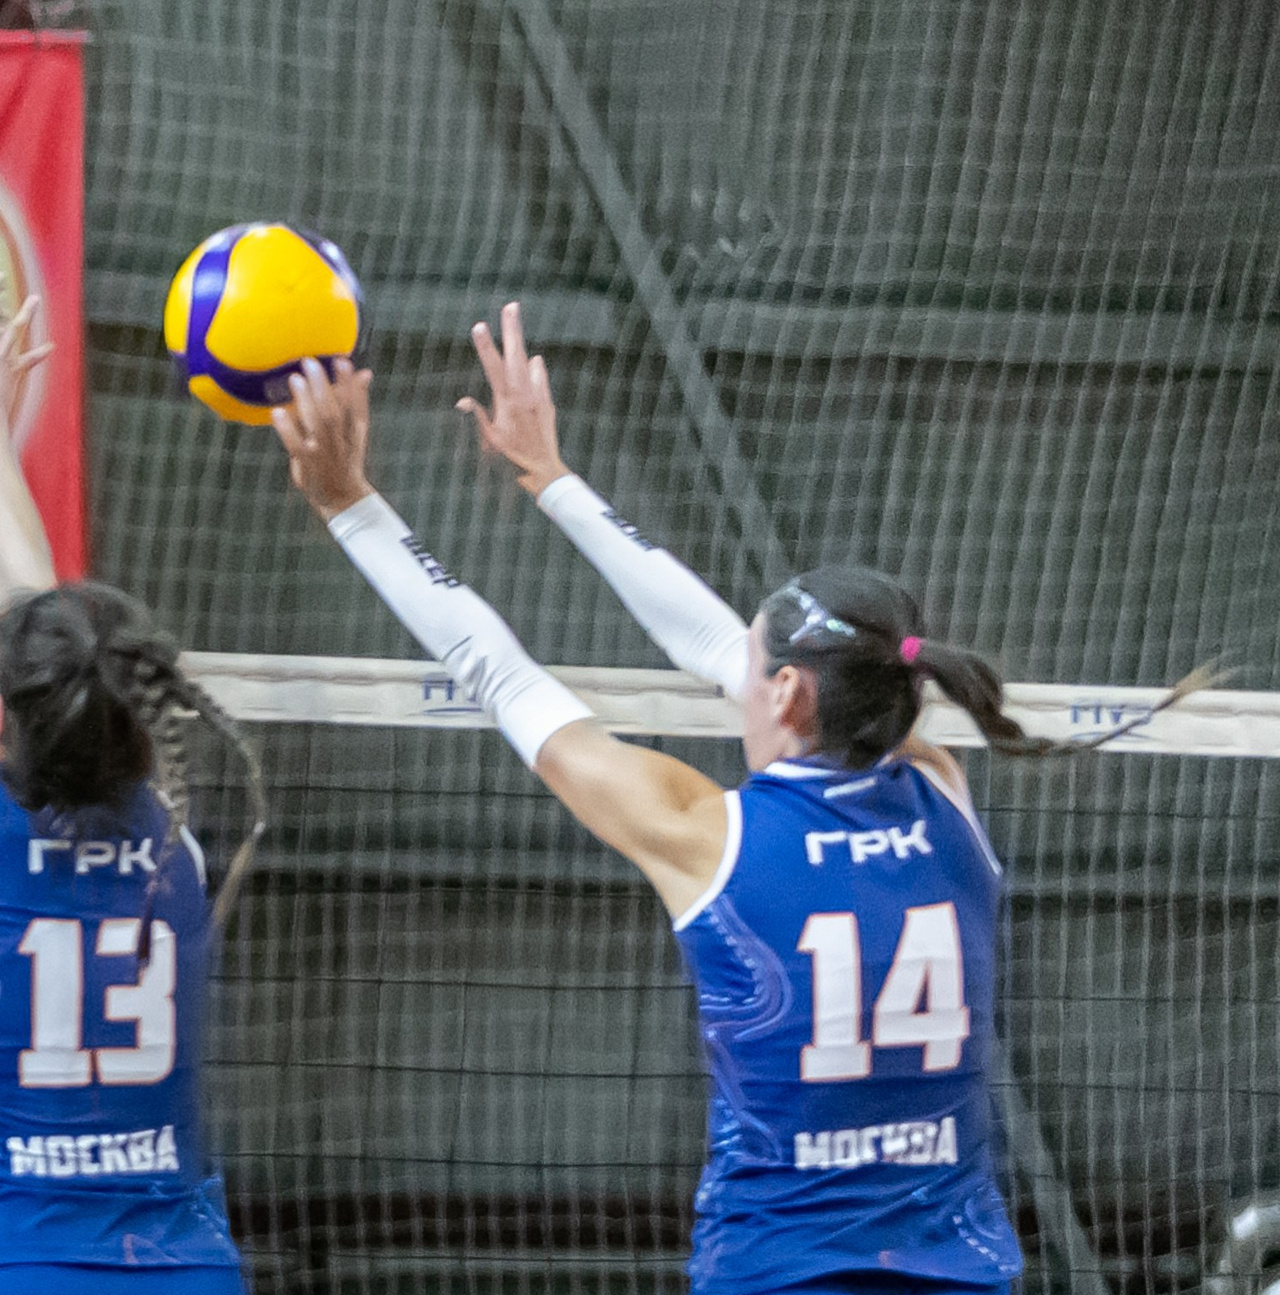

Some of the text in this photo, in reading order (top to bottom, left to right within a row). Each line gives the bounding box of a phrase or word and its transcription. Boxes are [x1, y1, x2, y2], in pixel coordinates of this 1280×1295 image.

[28, 837, 158, 875] ГРК
[805, 819, 933, 865] ГРК
[18, 917, 176, 1088] 13
[797, 901, 970, 1083] 14
[7, 1125, 180, 1177] МОСКВА
